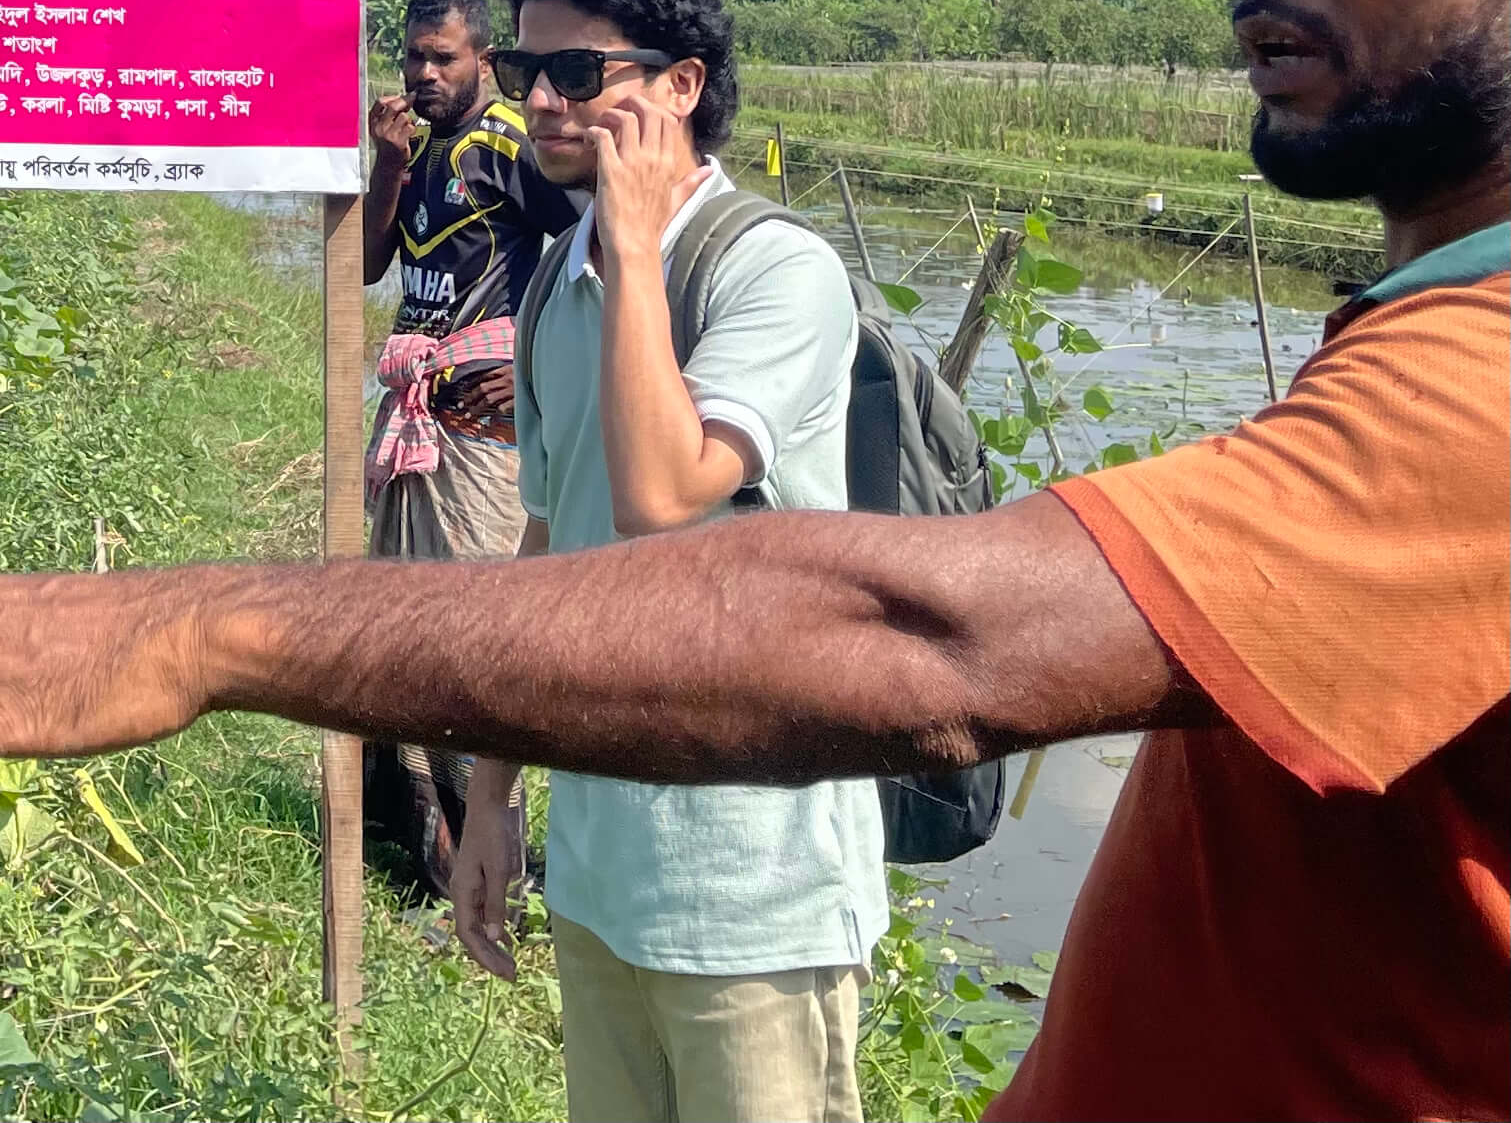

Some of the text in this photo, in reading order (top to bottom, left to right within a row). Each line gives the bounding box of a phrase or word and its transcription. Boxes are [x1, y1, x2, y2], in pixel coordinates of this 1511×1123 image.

[34, 3, 88, 25] ইসলাম
[93, 8, 126, 25] শেখ
[3, 37, 57, 54] শতাংশ
[79, 94, 112, 115] মিষ্টি
[220, 96, 251, 117] সীম
[23, 155, 89, 178] পরিবর্তন
[164, 164, 204, 179] ব্র্যাক
